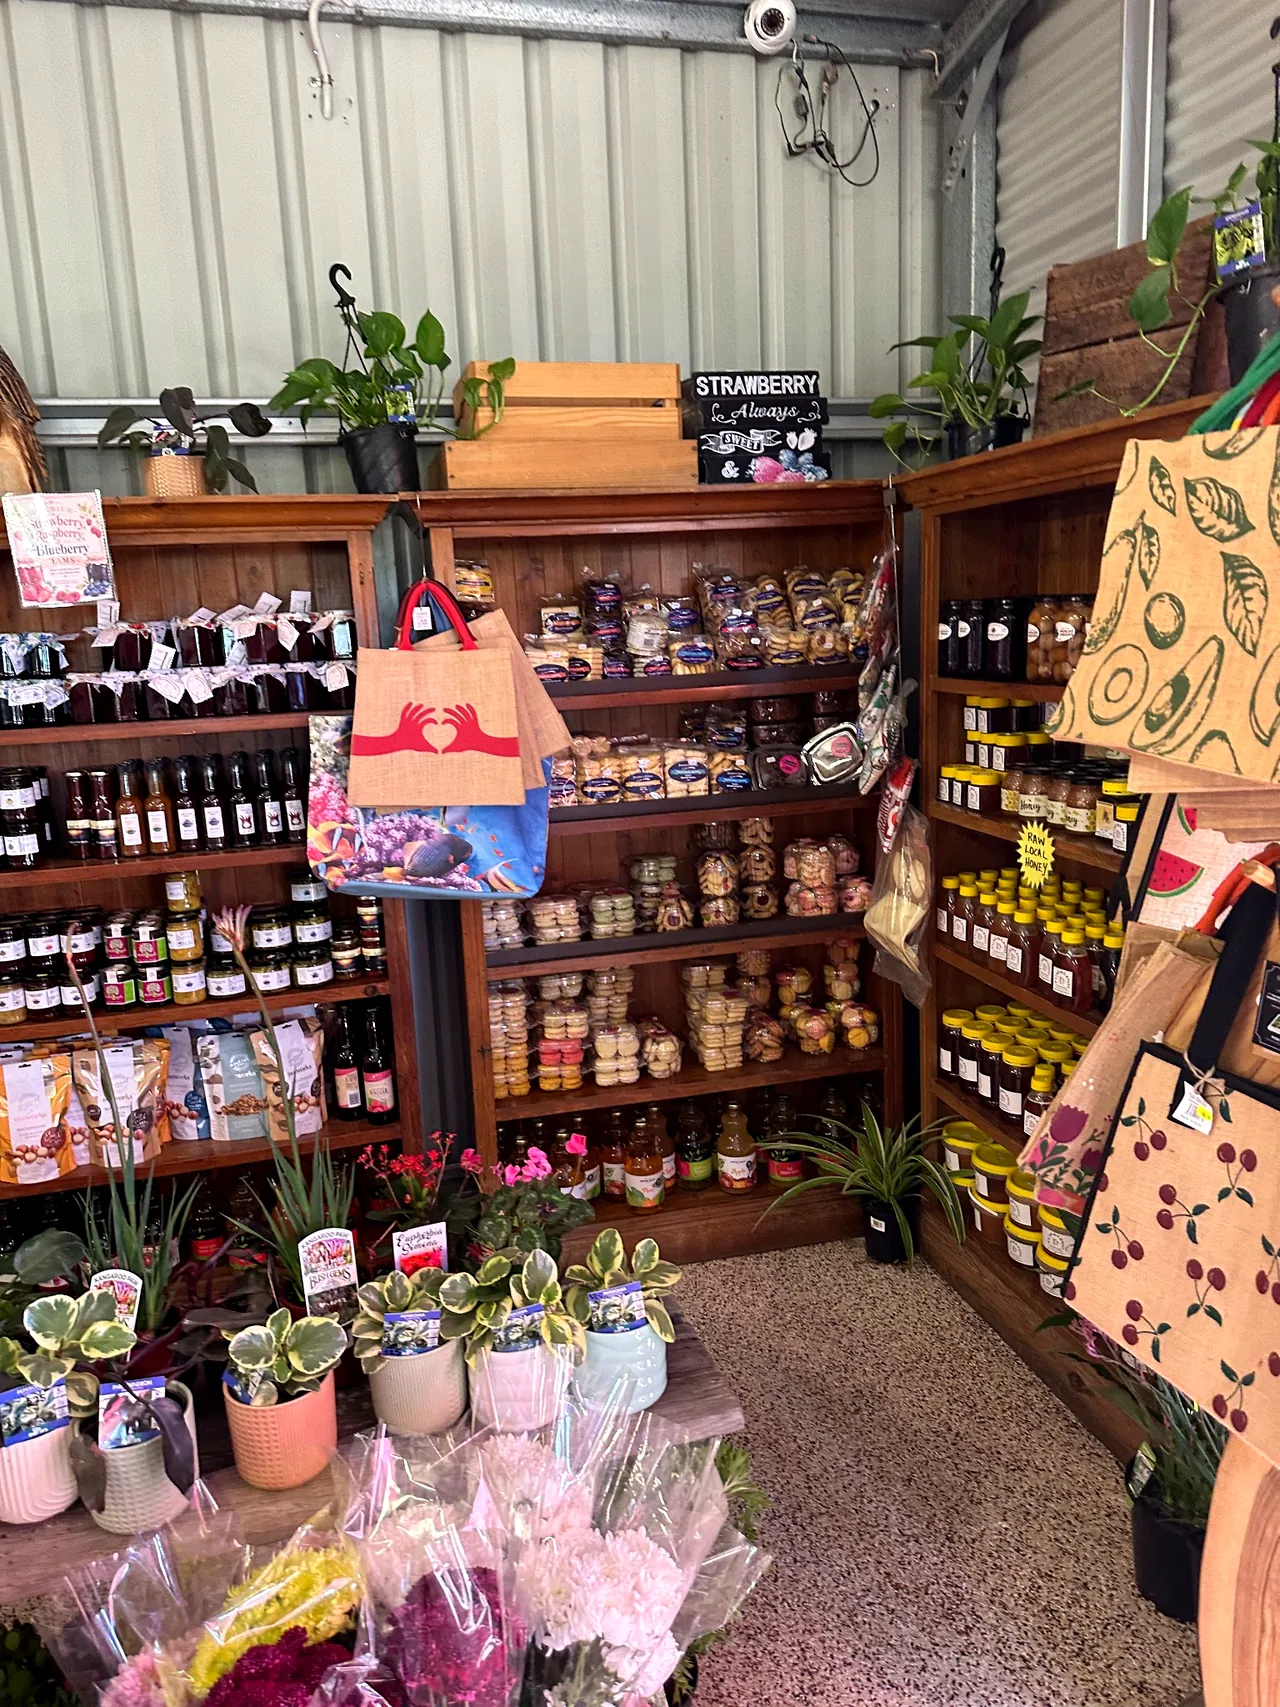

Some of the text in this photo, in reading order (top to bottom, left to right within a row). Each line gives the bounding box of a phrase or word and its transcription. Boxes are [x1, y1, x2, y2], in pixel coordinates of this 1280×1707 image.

[696, 374, 817, 396] STRAWBERRY
[730, 401, 799, 422] Always
[724, 433, 760, 450] SWEET
[721, 460, 740, 479] &
[31, 515, 86, 531] Strwberry,
[36, 543, 89, 557] Blueberry
[1020, 798, 1041, 814] Honey
[1027, 831, 1046, 847] RAW
[1024, 844, 1049, 861] LOCAL
[1024, 856, 1049, 877] HONEY
[301, 1231, 335, 1249] KANGAROO
[395, 1228, 443, 1248] Euphorbia
[94, 1272, 127, 1283] KANGAROO
